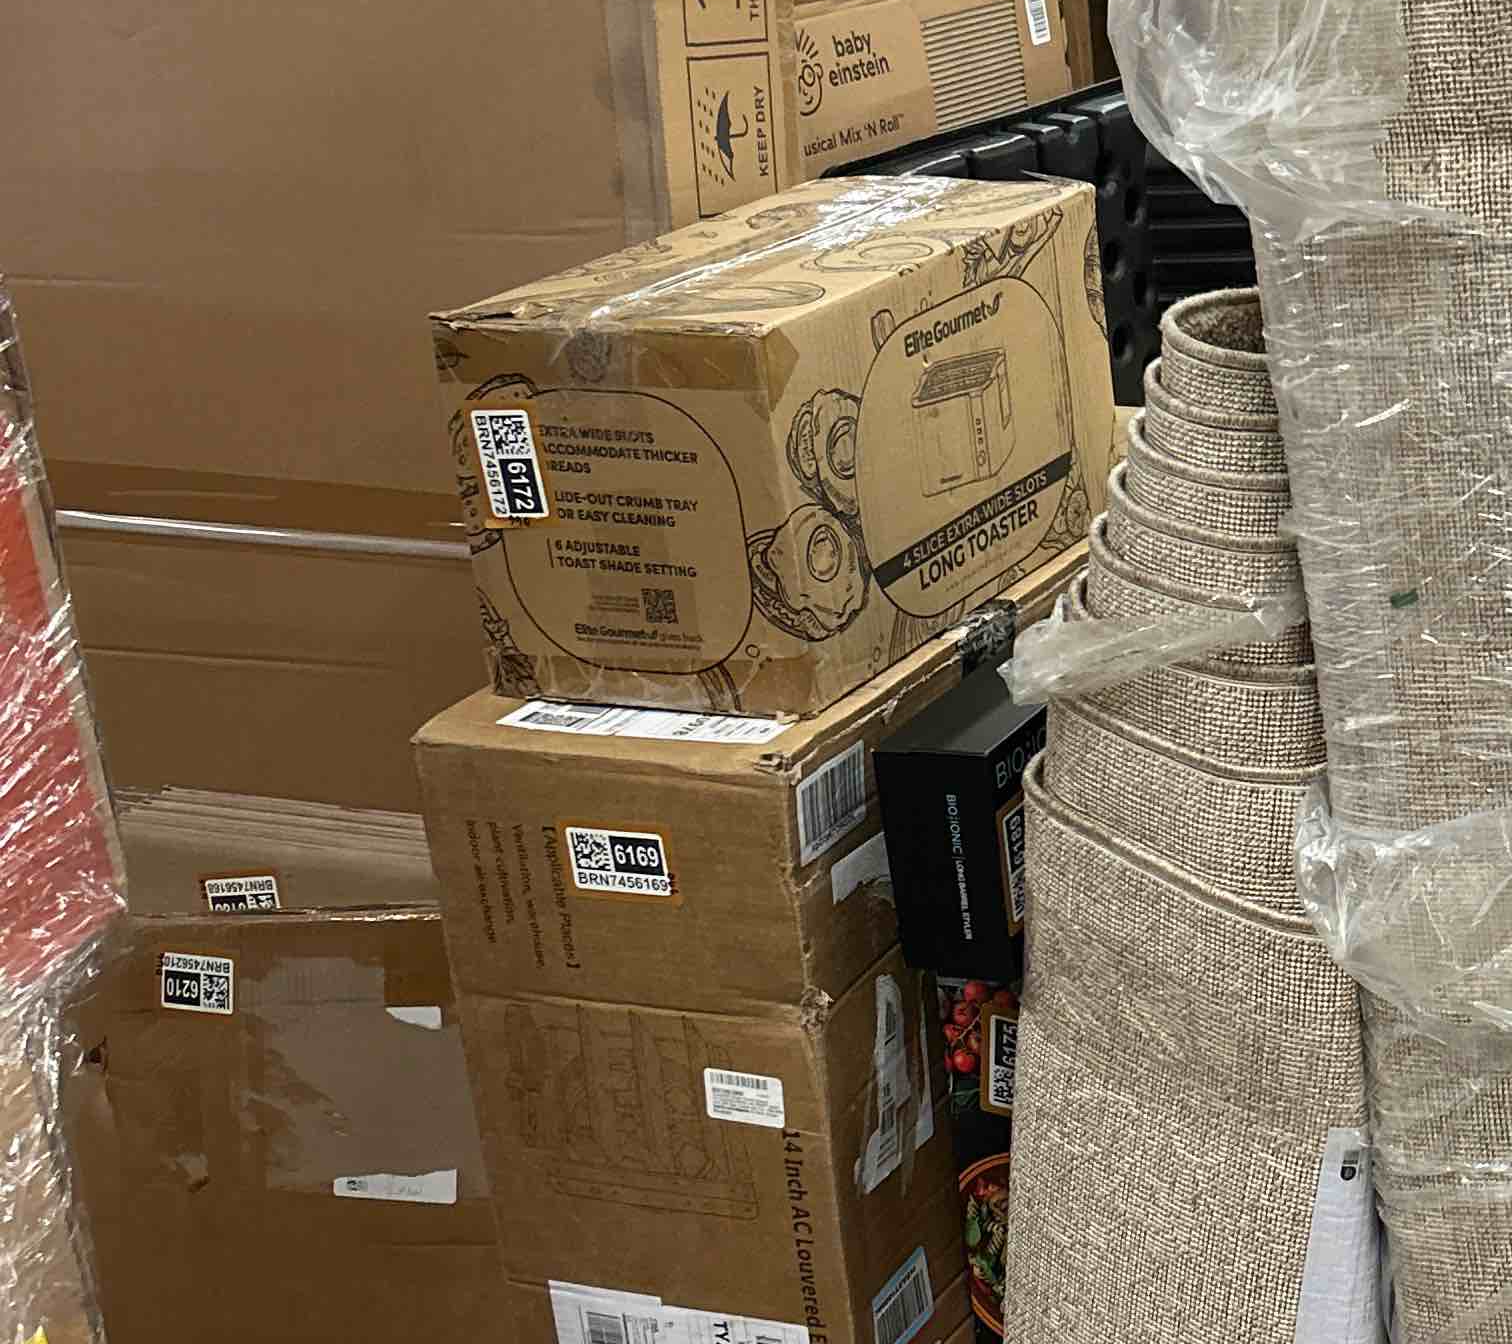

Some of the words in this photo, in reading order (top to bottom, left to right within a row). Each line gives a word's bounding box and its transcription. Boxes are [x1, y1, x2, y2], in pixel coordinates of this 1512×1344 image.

[831, 30, 871, 58] baby
[828, 52, 890, 87] einstein
[752, 85, 767, 123] DRY
[753, 129, 769, 177] KEEP
[803, 132, 837, 157] usical
[839, 126, 863, 146] Mix
[903, 327, 933, 358] Elite
[933, 299, 989, 345] Gourmet
[474, 415, 508, 515] BRN7456172
[642, 448, 698, 465] THICKER
[506, 461, 535, 512] 6172
[577, 509, 609, 523] EASY
[612, 511, 676, 528] CLEANING
[616, 494, 664, 511] CRUMB
[665, 498, 698, 513] TRAY
[945, 512, 980, 543] EXTRA
[981, 490, 1013, 517] WIDE
[1013, 472, 1049, 500] SLOTS
[554, 539, 563, 551] 6
[565, 539, 641, 557] ADJUSTABLE
[918, 544, 966, 591] LONG
[967, 499, 1039, 559] TOASTER
[557, 555, 599, 570] TOAST
[599, 559, 642, 574] SHADE
[644, 563, 697, 579] SETTING
[614, 843, 658, 867] 6169
[577, 870, 669, 892] BRN7456169
[163, 955, 231, 974] BRN7456210
[166, 977, 199, 999] 6210
[1000, 1024, 1018, 1067] 6175
[782, 1126, 803, 1155] 14
[784, 1157, 808, 1202] Inch
[791, 1205, 813, 1235] AC
[796, 1239, 827, 1330] Louvered
